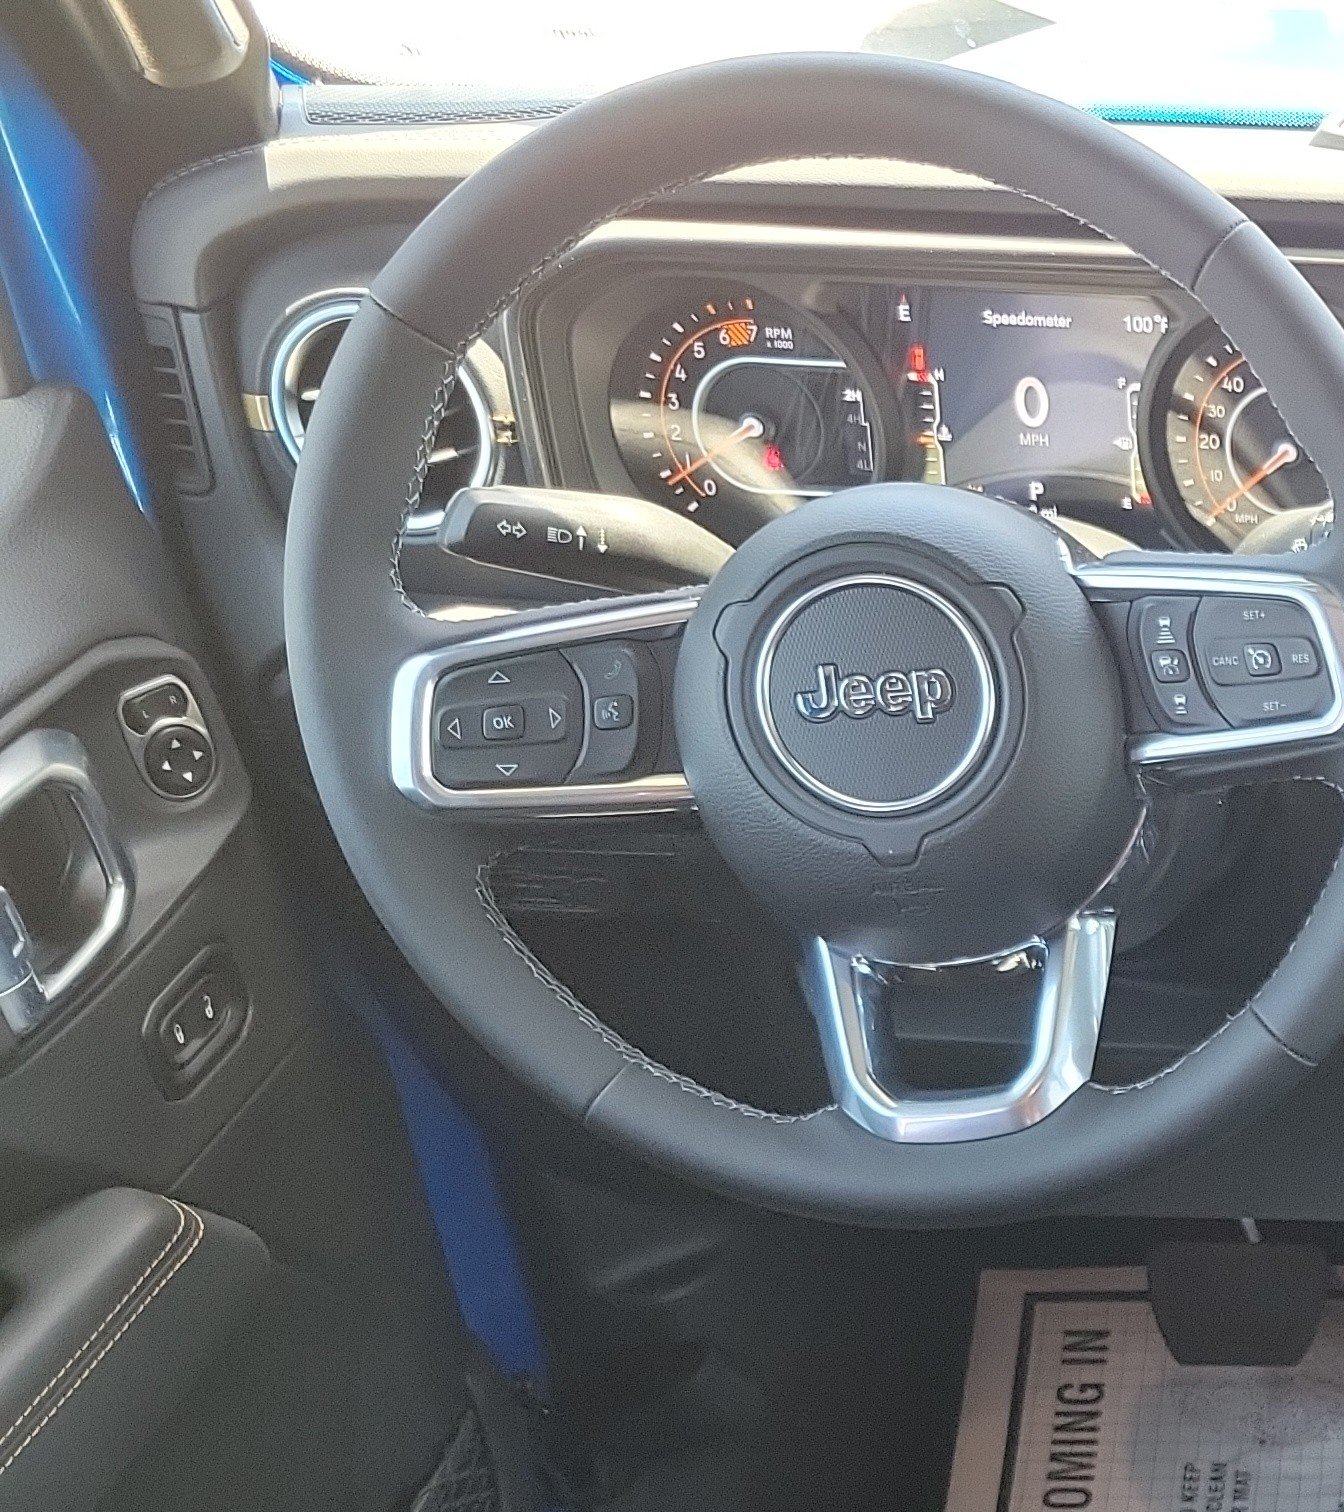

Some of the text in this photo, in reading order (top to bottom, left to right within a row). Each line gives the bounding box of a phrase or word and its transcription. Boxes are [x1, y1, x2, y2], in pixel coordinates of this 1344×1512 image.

[898, 305, 911, 322] E
[982, 310, 1072, 329] Speedometer
[719, 326, 757, 344] 6 7
[765, 328, 793, 339] RPM
[693, 342, 705, 359] 5
[774, 340, 793, 350] 1000
[675, 364, 687, 381] 4
[1222, 377, 1244, 393] 40
[667, 393, 679, 410] 3
[841, 389, 861, 401] 2H
[1014, 376, 1049, 428] 0
[1207, 405, 1225, 418] 30
[670, 425, 682, 441] 2
[1019, 434, 1049, 447] MPH
[1199, 435, 1220, 449] 20
[1210, 470, 1223, 482] 10
[704, 479, 716, 496] 0
[1029, 481, 1044, 500] P
[1235, 514, 1259, 523] MPH
[1213, 654, 1309, 666] CANC RES
[795, 663, 955, 724] Jeep
[493, 716, 514, 729] OK
[1061, 1328, 1110, 1365] IN
[1180, 1461, 1201, 1504] KEEP
[1203, 1461, 1228, 1512] CLEAN
[1232, 1469, 1251, 1501] MAT
